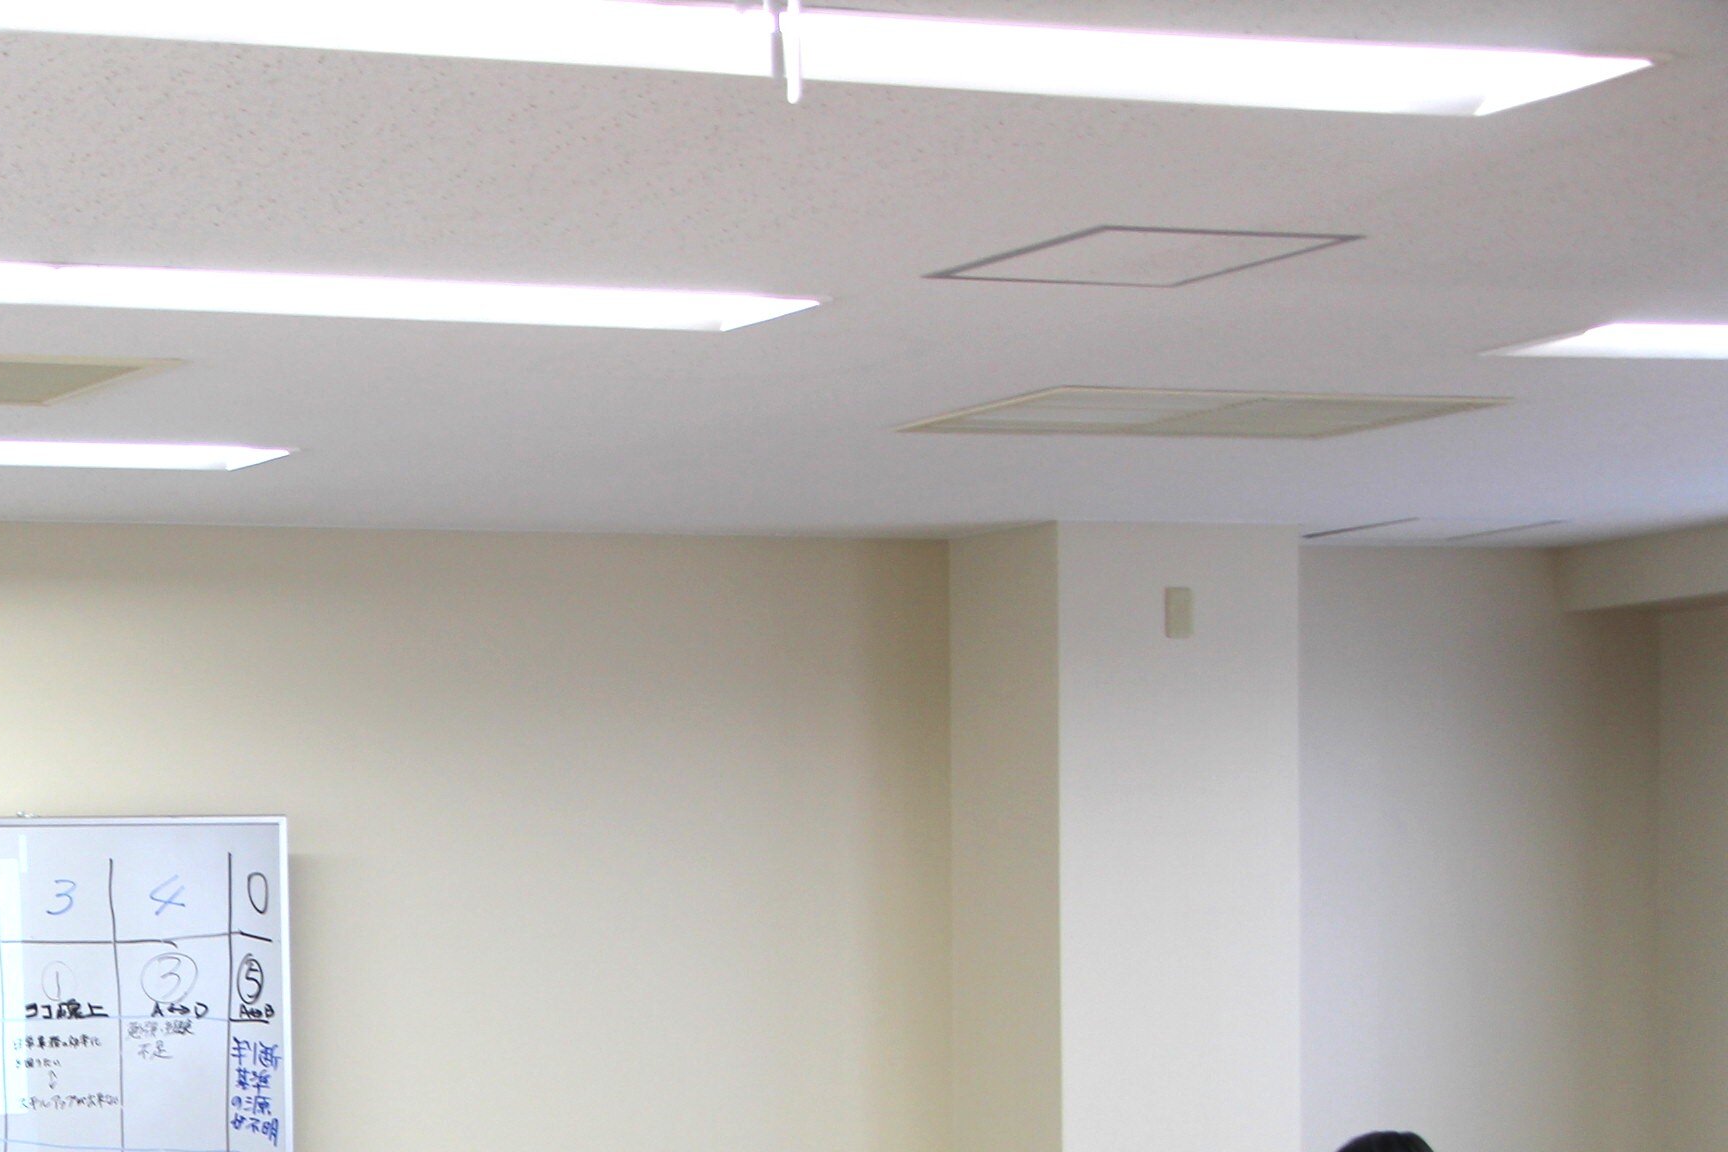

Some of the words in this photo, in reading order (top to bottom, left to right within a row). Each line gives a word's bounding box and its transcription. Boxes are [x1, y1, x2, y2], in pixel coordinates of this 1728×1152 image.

[46, 879, 76, 916] 3
[149, 874, 186, 916] 4
[247, 872, 268, 914] 0
